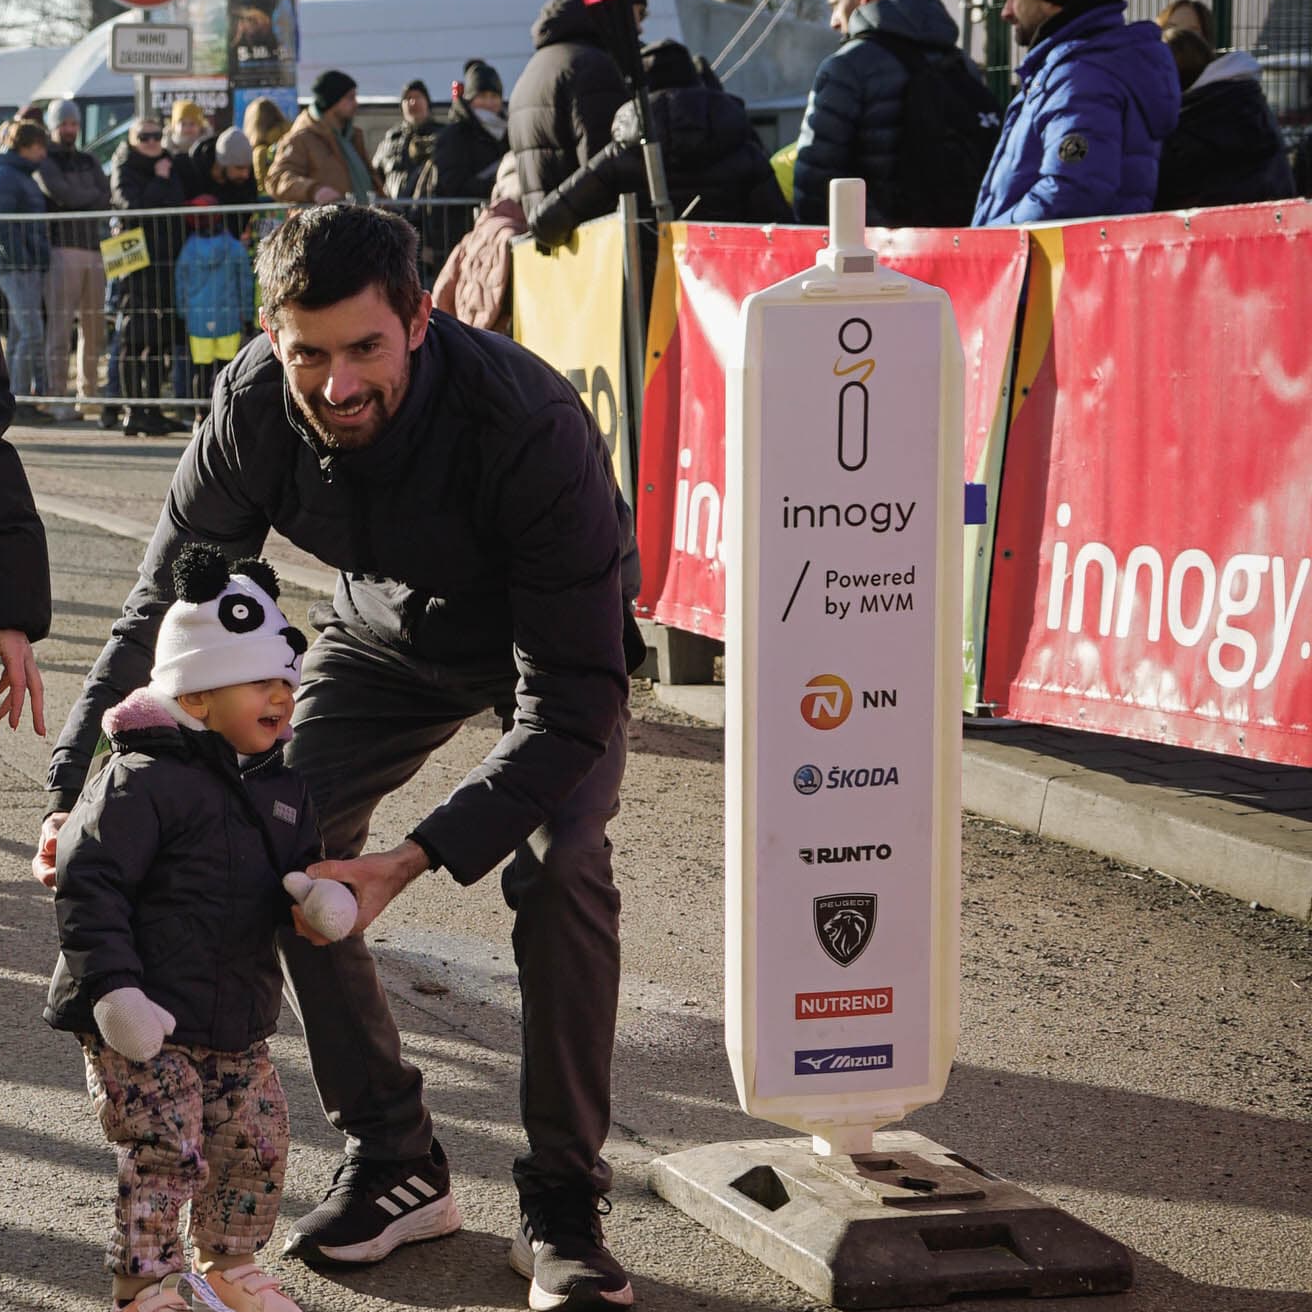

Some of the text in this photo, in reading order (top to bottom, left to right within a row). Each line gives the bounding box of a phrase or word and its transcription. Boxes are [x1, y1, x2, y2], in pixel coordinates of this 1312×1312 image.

[783, 496, 916, 533] innogy
[826, 566, 915, 589] Powered
[825, 593, 914, 620] by MVM
[862, 689, 897, 709] NN
[826, 766, 899, 789] ŠKODA
[817, 844, 892, 864] RUNTO
[819, 899, 871, 909] PEUGEOT
[801, 994, 889, 1014] NUTREND
[829, 1055, 887, 1069] MIZUNO
